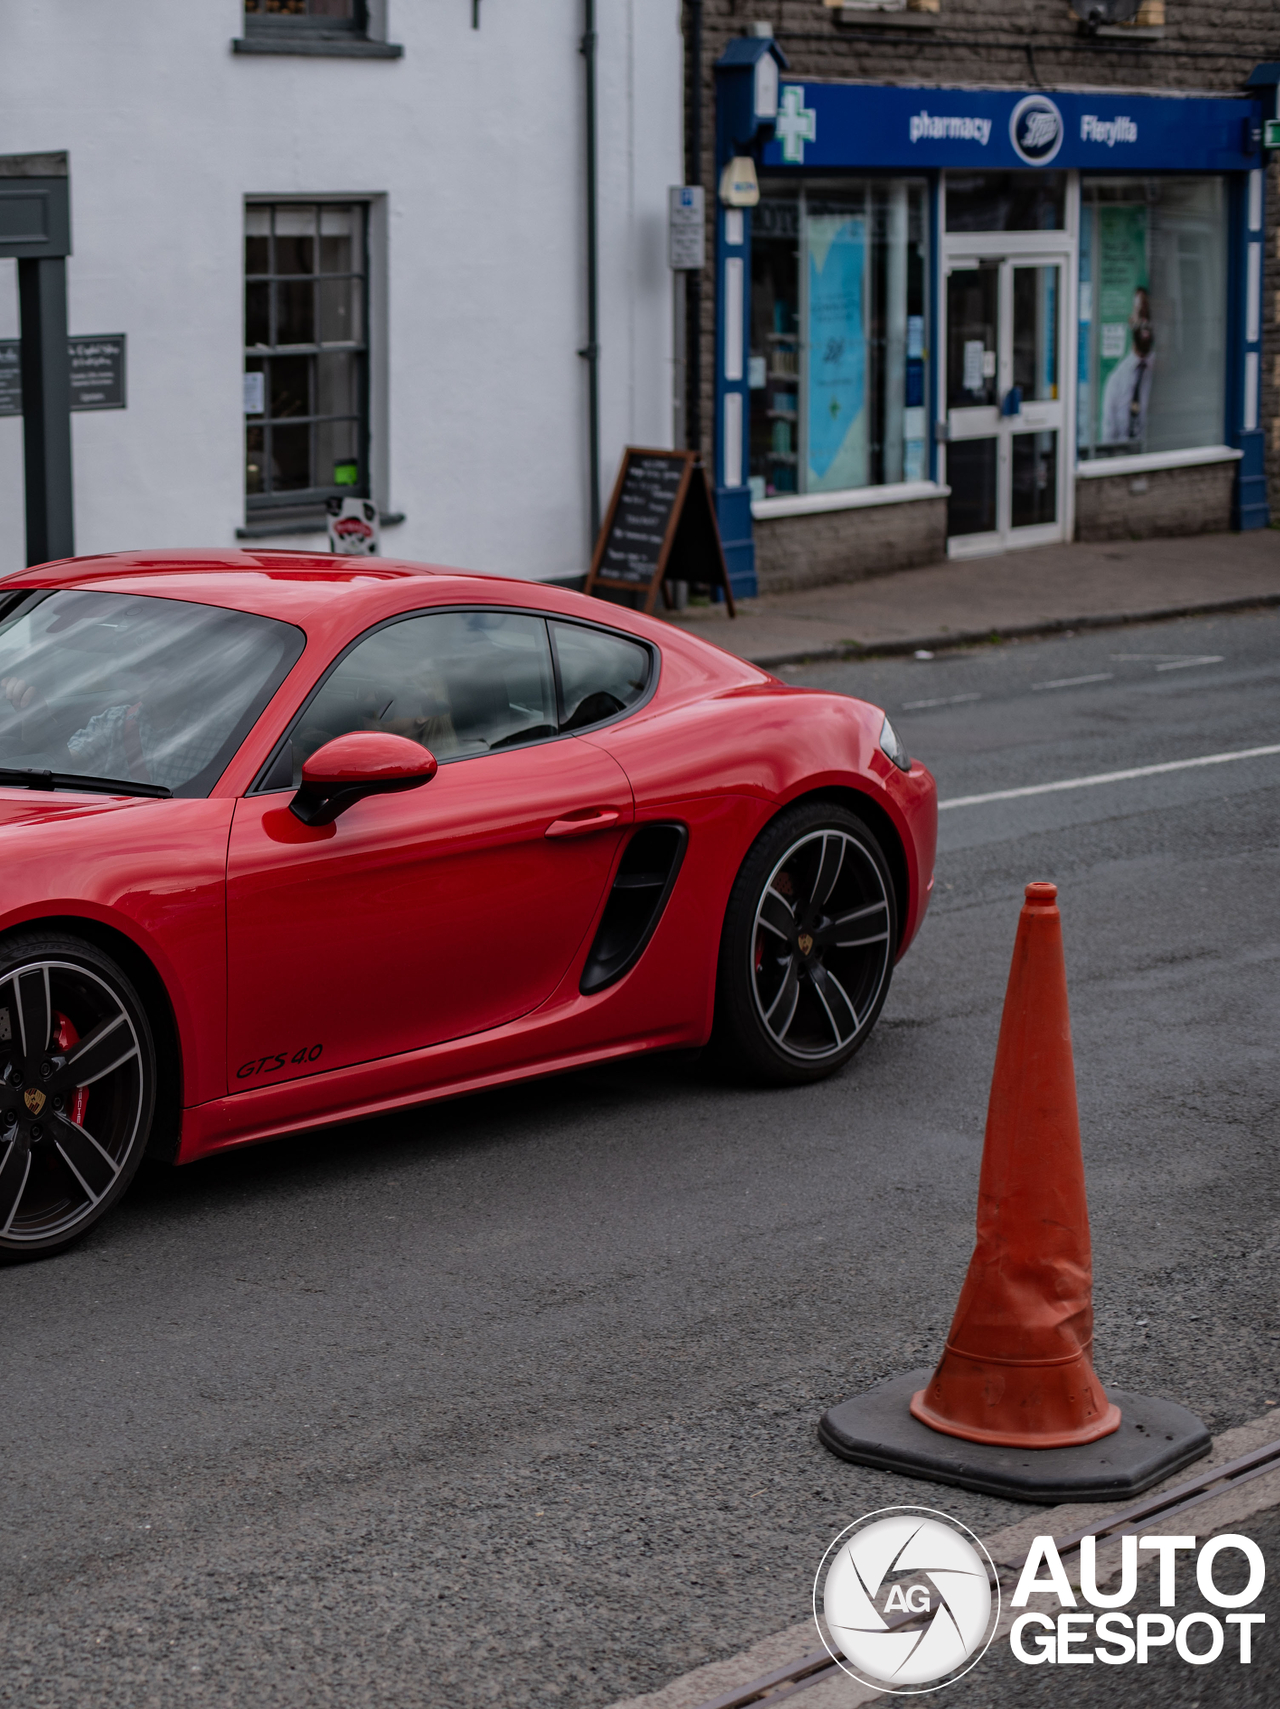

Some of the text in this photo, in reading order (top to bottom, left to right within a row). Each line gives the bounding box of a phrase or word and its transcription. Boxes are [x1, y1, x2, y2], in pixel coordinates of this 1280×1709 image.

[909, 110, 992, 147] pharmacy
[236, 1043, 323, 1079] GTS 4.0
